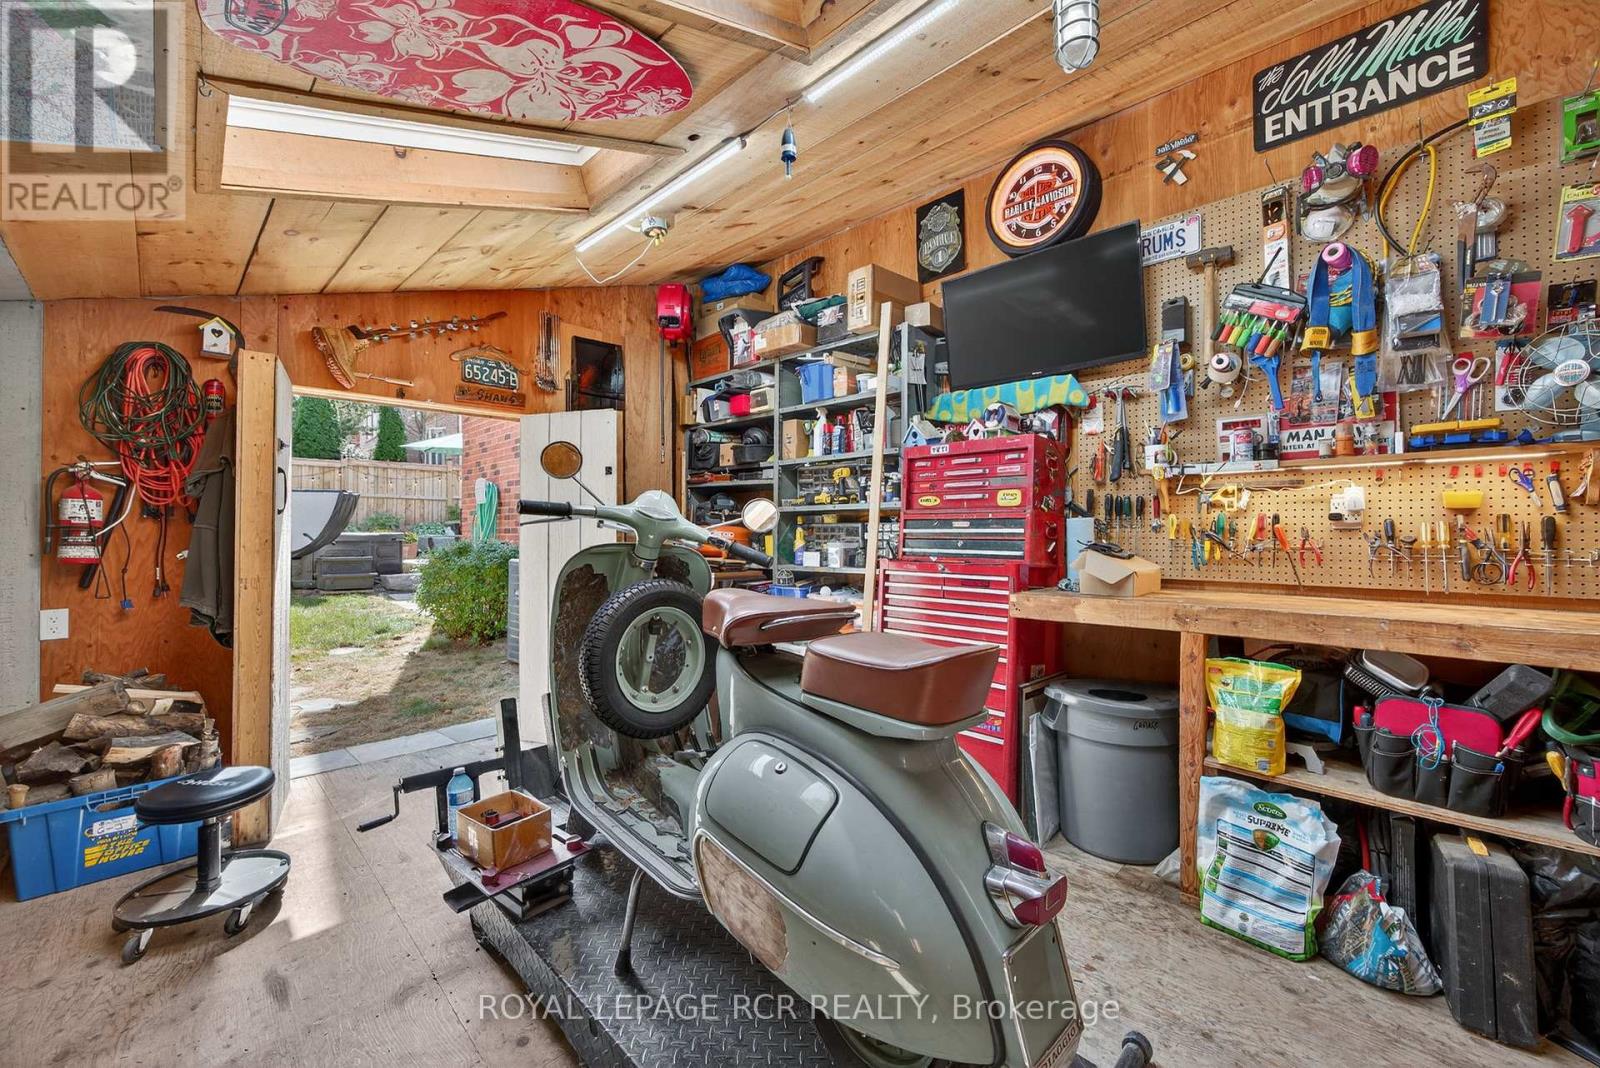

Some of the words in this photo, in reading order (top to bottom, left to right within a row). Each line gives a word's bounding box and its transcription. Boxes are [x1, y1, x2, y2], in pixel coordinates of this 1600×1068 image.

[1261, 37, 1368, 114] Jolly
[1351, 0, 1479, 81] Miller
[1264, 42, 1475, 144] ENTRANCE
[1287, 428, 1325, 443] MAN
[1247, 815, 1291, 837] SUPREME
